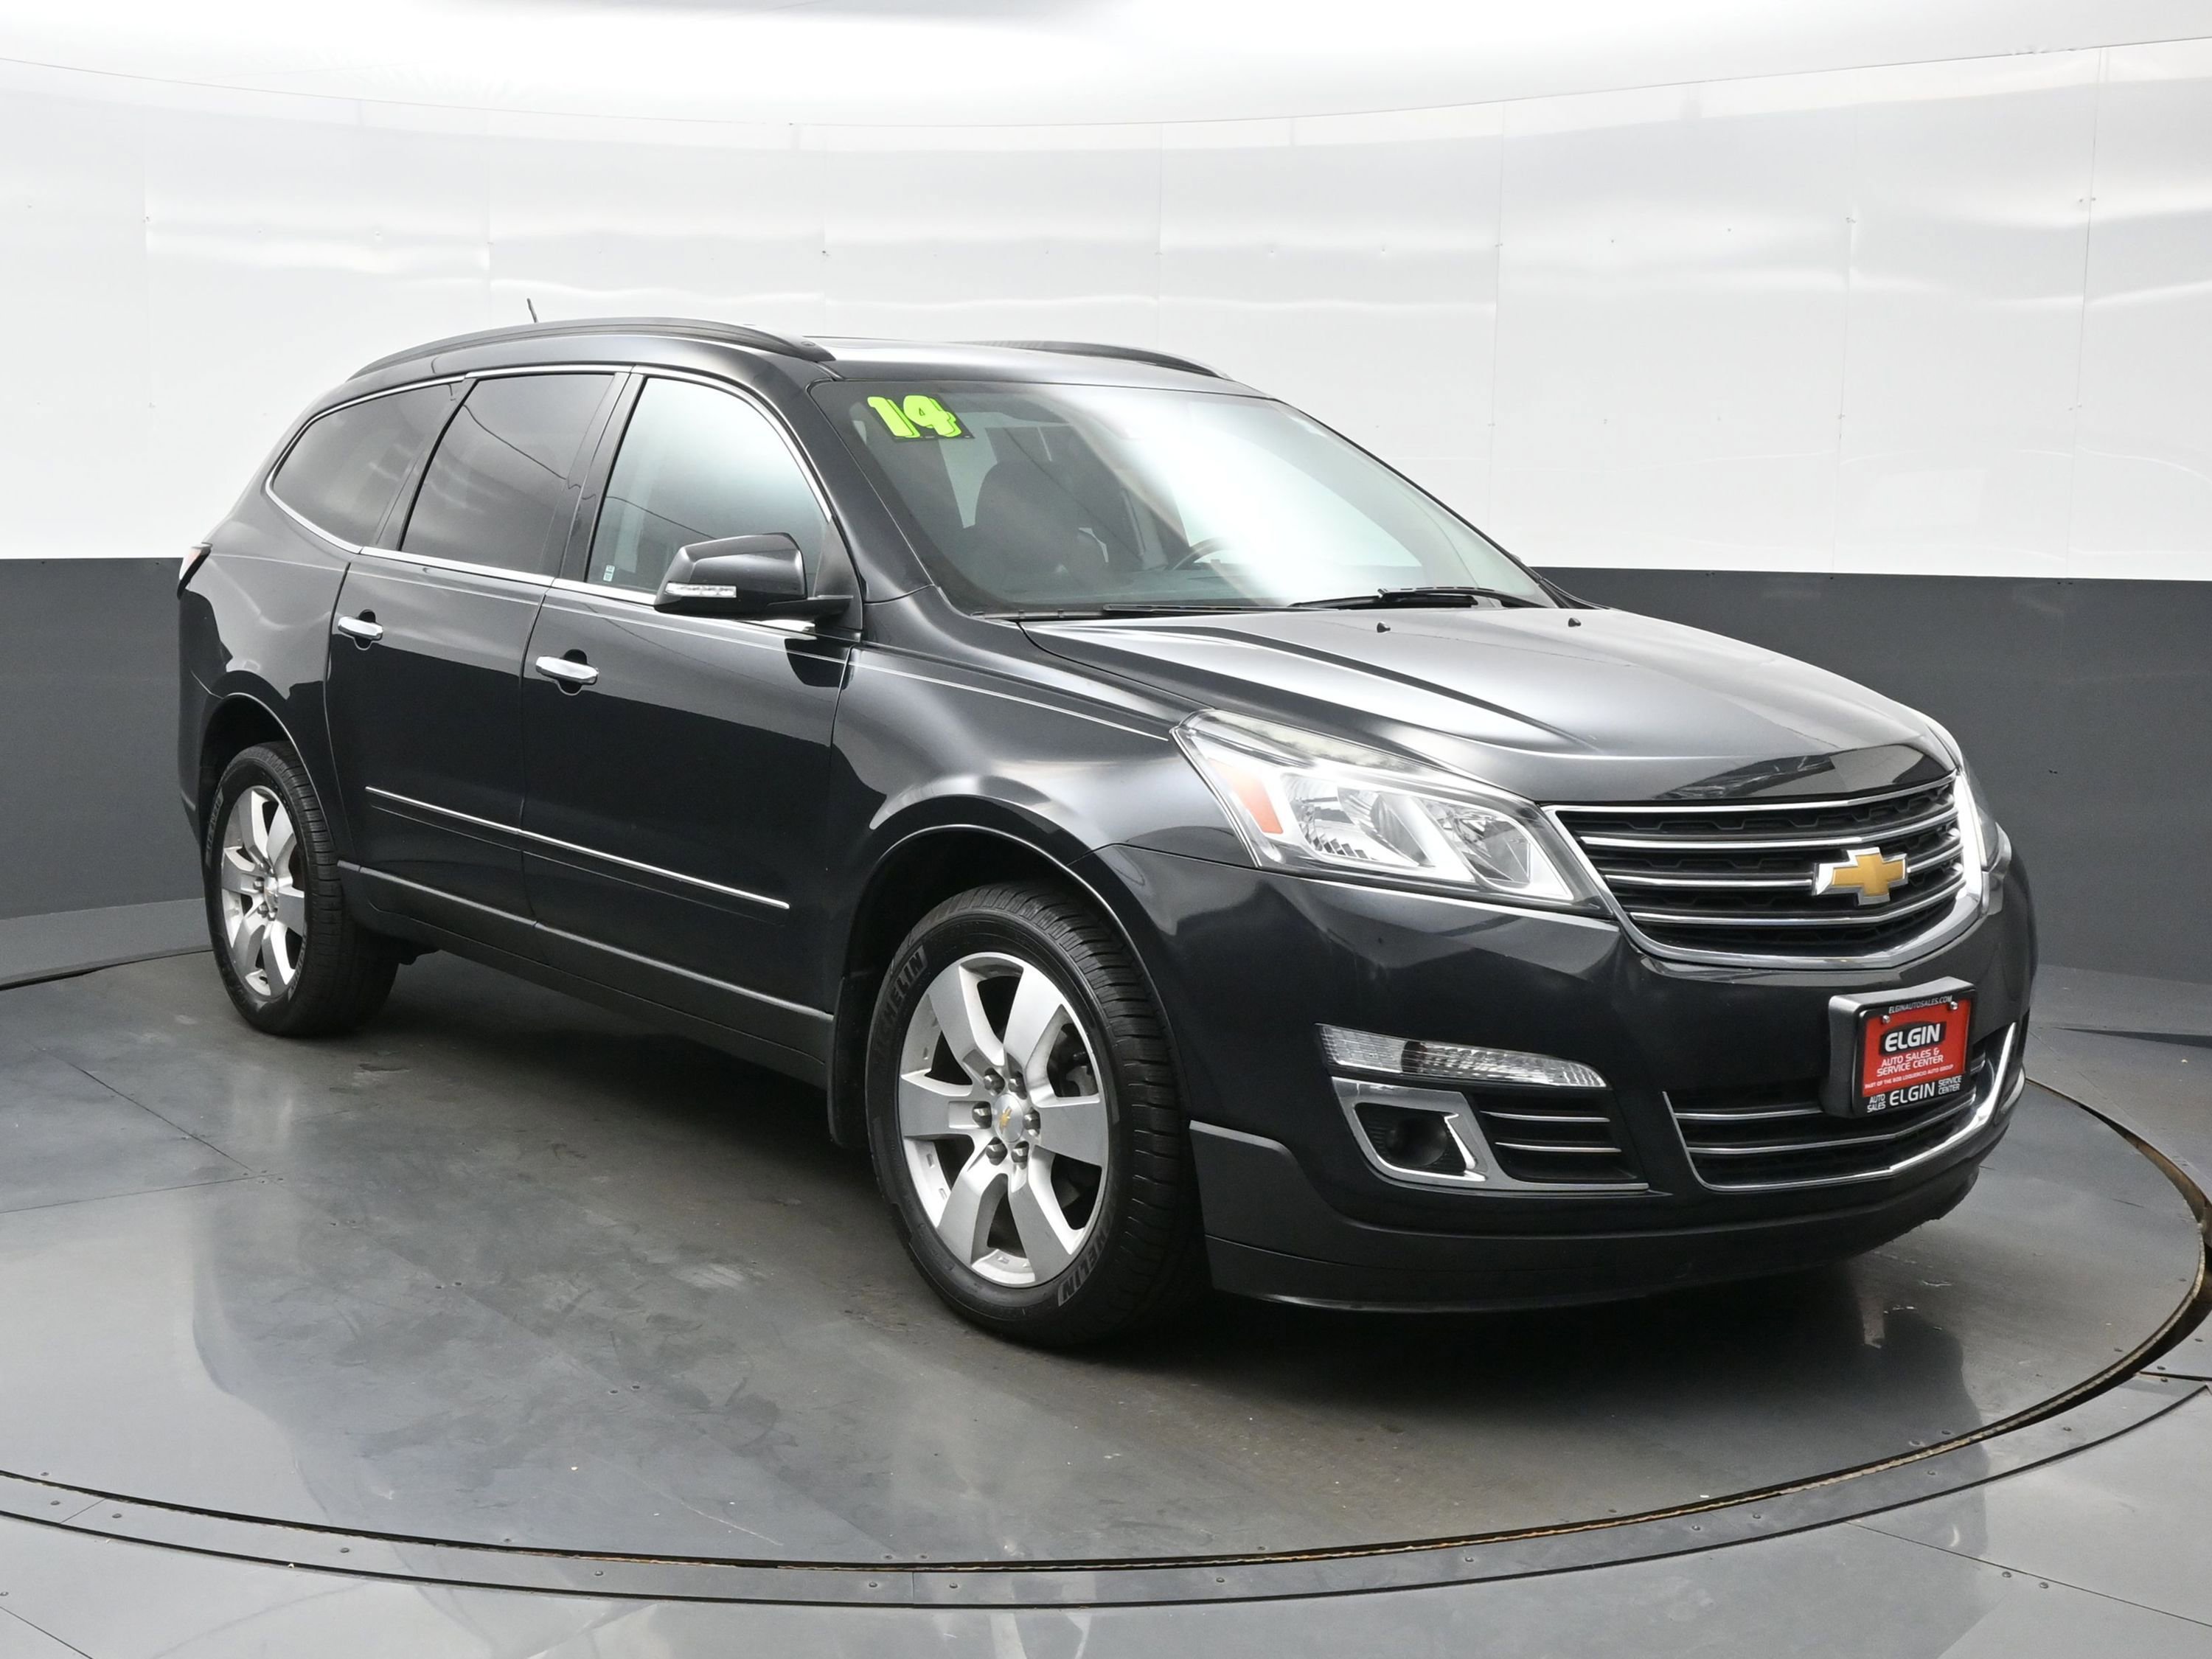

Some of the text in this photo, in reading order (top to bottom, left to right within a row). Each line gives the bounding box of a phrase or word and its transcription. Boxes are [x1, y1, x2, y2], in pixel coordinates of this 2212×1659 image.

[867, 394, 961, 438] 14
[1888, 995, 1952, 1014] ELGINAUTOSALES.COM
[1885, 1023, 1941, 1052] ELGIN
[1877, 1054, 1944, 1077] SERVICE CENTER
[1881, 1047, 1940, 1067] AUTO SALES &
[1938, 1075, 1962, 1088] SERVICE
[1938, 1083, 1960, 1095] CENTER
[1869, 1093, 1885, 1104] AUTO
[1889, 1082, 1935, 1106] ELGIN
[1867, 1101, 1886, 1113] SALES
